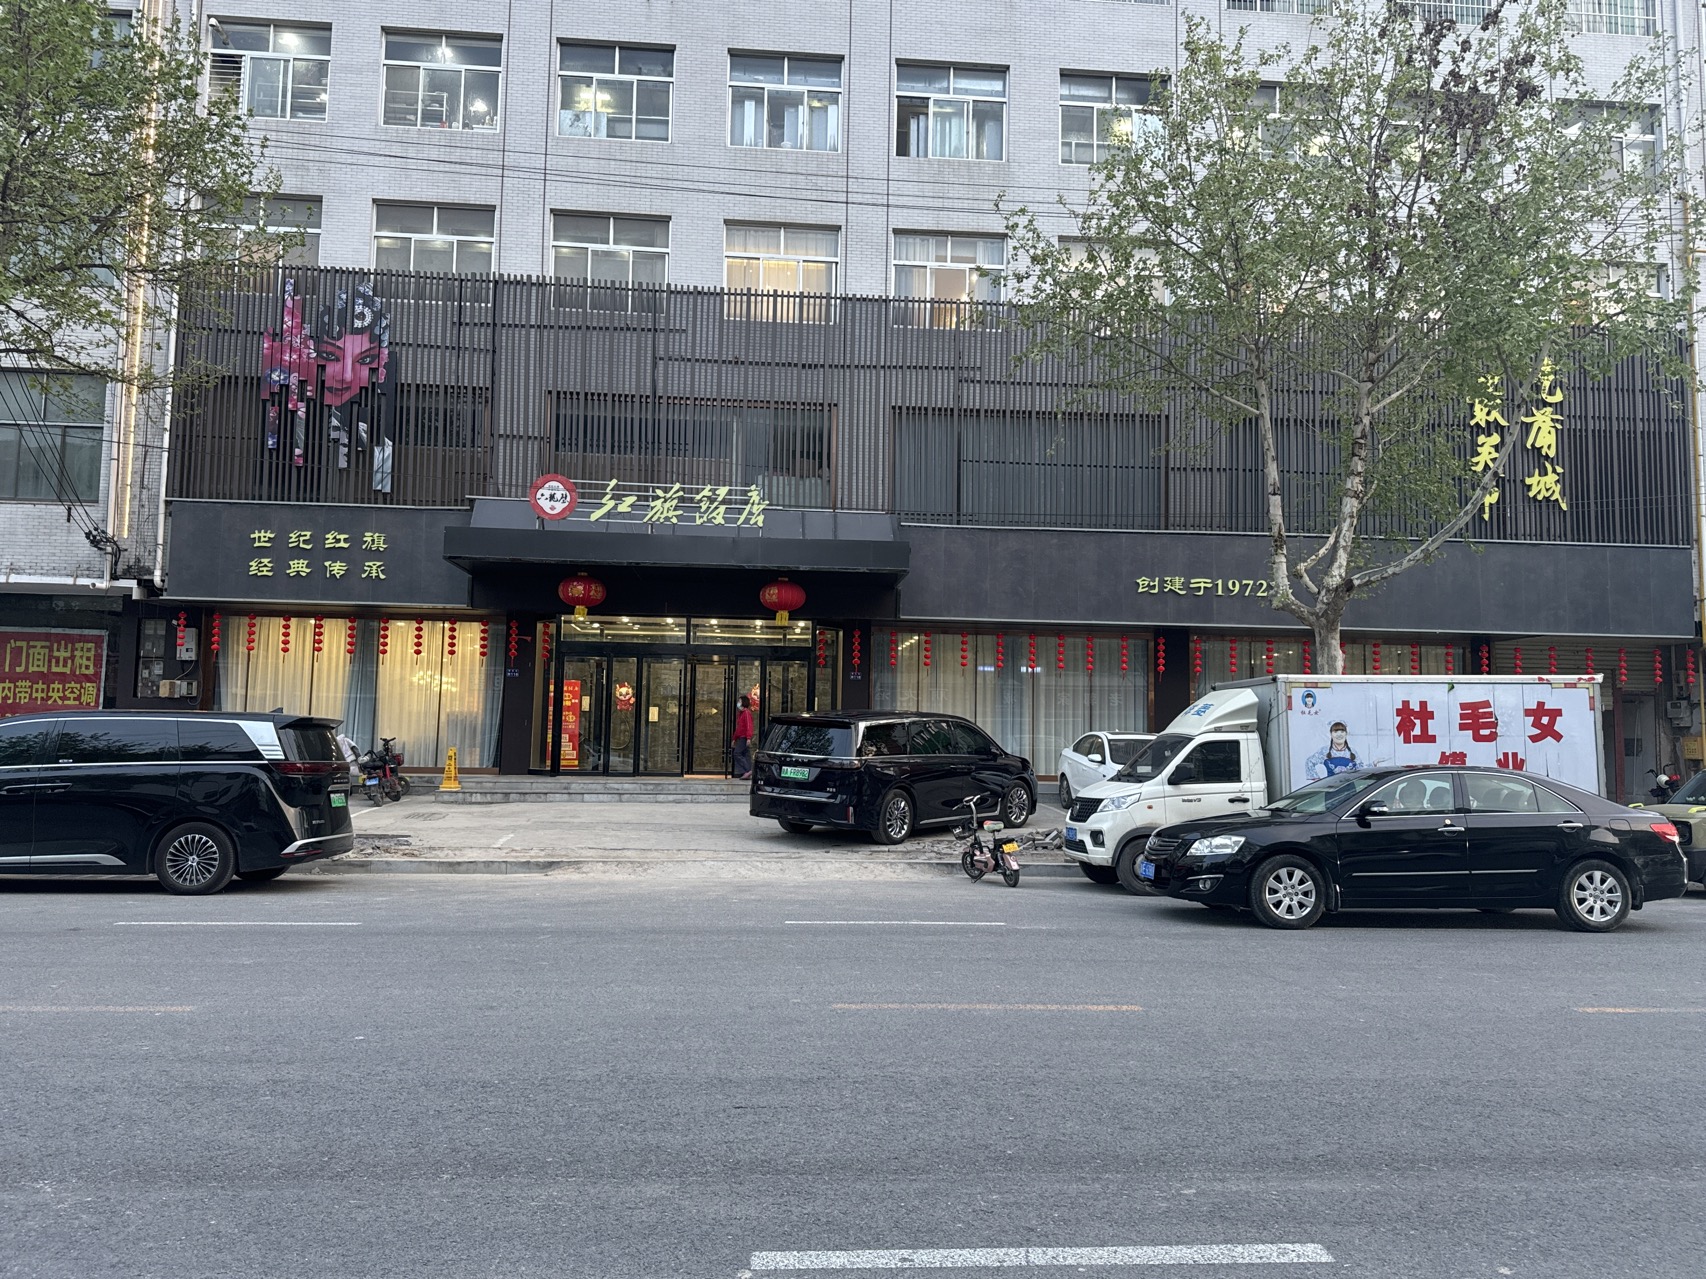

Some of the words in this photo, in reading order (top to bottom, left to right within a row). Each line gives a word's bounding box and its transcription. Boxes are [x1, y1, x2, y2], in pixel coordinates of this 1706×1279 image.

[249, 529, 389, 552] 世纪红旗
[248, 557, 387, 580] 经典传承
[1135, 576, 1269, 597] 创建于1972
[4, 638, 96, 675] 门面出租
[0, 679, 97, 706] 内带中央空调
[1395, 699, 1564, 744] 杜毛女
